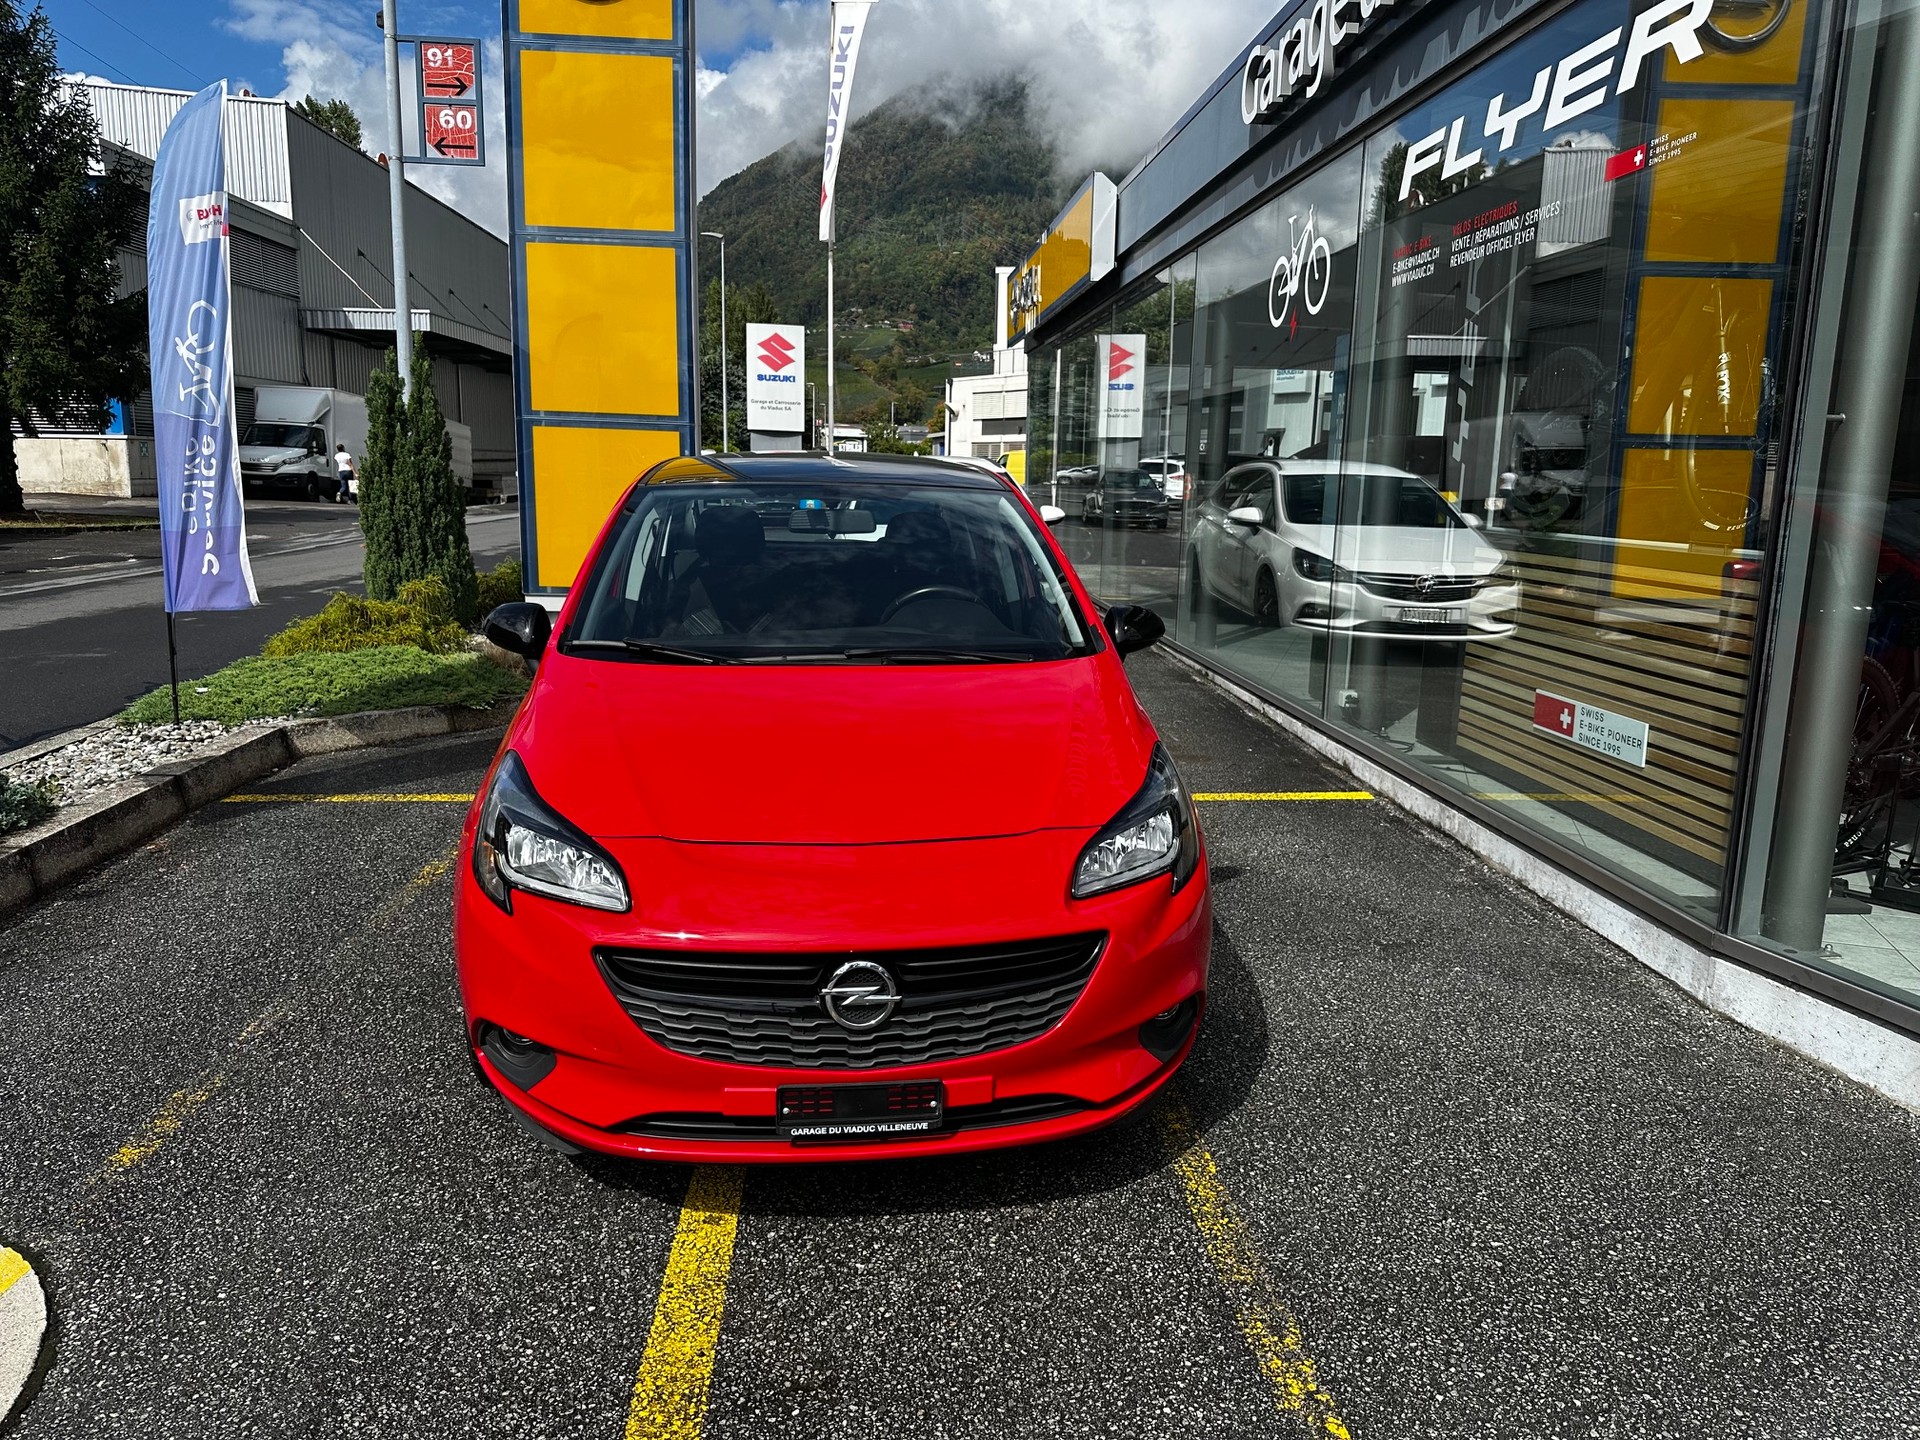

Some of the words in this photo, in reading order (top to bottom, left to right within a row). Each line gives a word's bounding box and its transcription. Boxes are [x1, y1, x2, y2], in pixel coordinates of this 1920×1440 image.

[426, 47, 454, 68] 91
[1241, 0, 1356, 125] Garage
[825, 25, 855, 171] SUZUKI
[1398, 0, 1713, 202] FLYER
[439, 109, 473, 130] 60
[1649, 143, 1669, 157] E-BIKE
[1671, 132, 1697, 147] PIONEER
[1650, 133, 1670, 147] SWISS
[1648, 152, 1666, 167] SINCE
[1667, 147, 1682, 159] 1995
[1451, 234, 1471, 253] VENTE
[1474, 215, 1520, 245] RÉPARATIONS
[1524, 200, 1561, 227] SERVICES
[1449, 245, 1486, 269] REVENDEUR
[1485, 236, 1513, 256] OFFICIEL
[1513, 227, 1536, 246] FLYER
[757, 374, 795, 382] SUZUKI
[1580, 706, 1605, 722] SWISS
[1578, 732, 1601, 749] SINCE
[1602, 741, 1621, 756] 1995
[1579, 719, 1605, 736] E-BIKE
[1607, 729, 1642, 749] PIONEER
[790, 1127, 828, 1136] GARAGE
[828, 1126, 842, 1134] DU
[843, 1124, 876, 1134] VIADUC
[876, 1122, 929, 1132] VILLENEUVE
